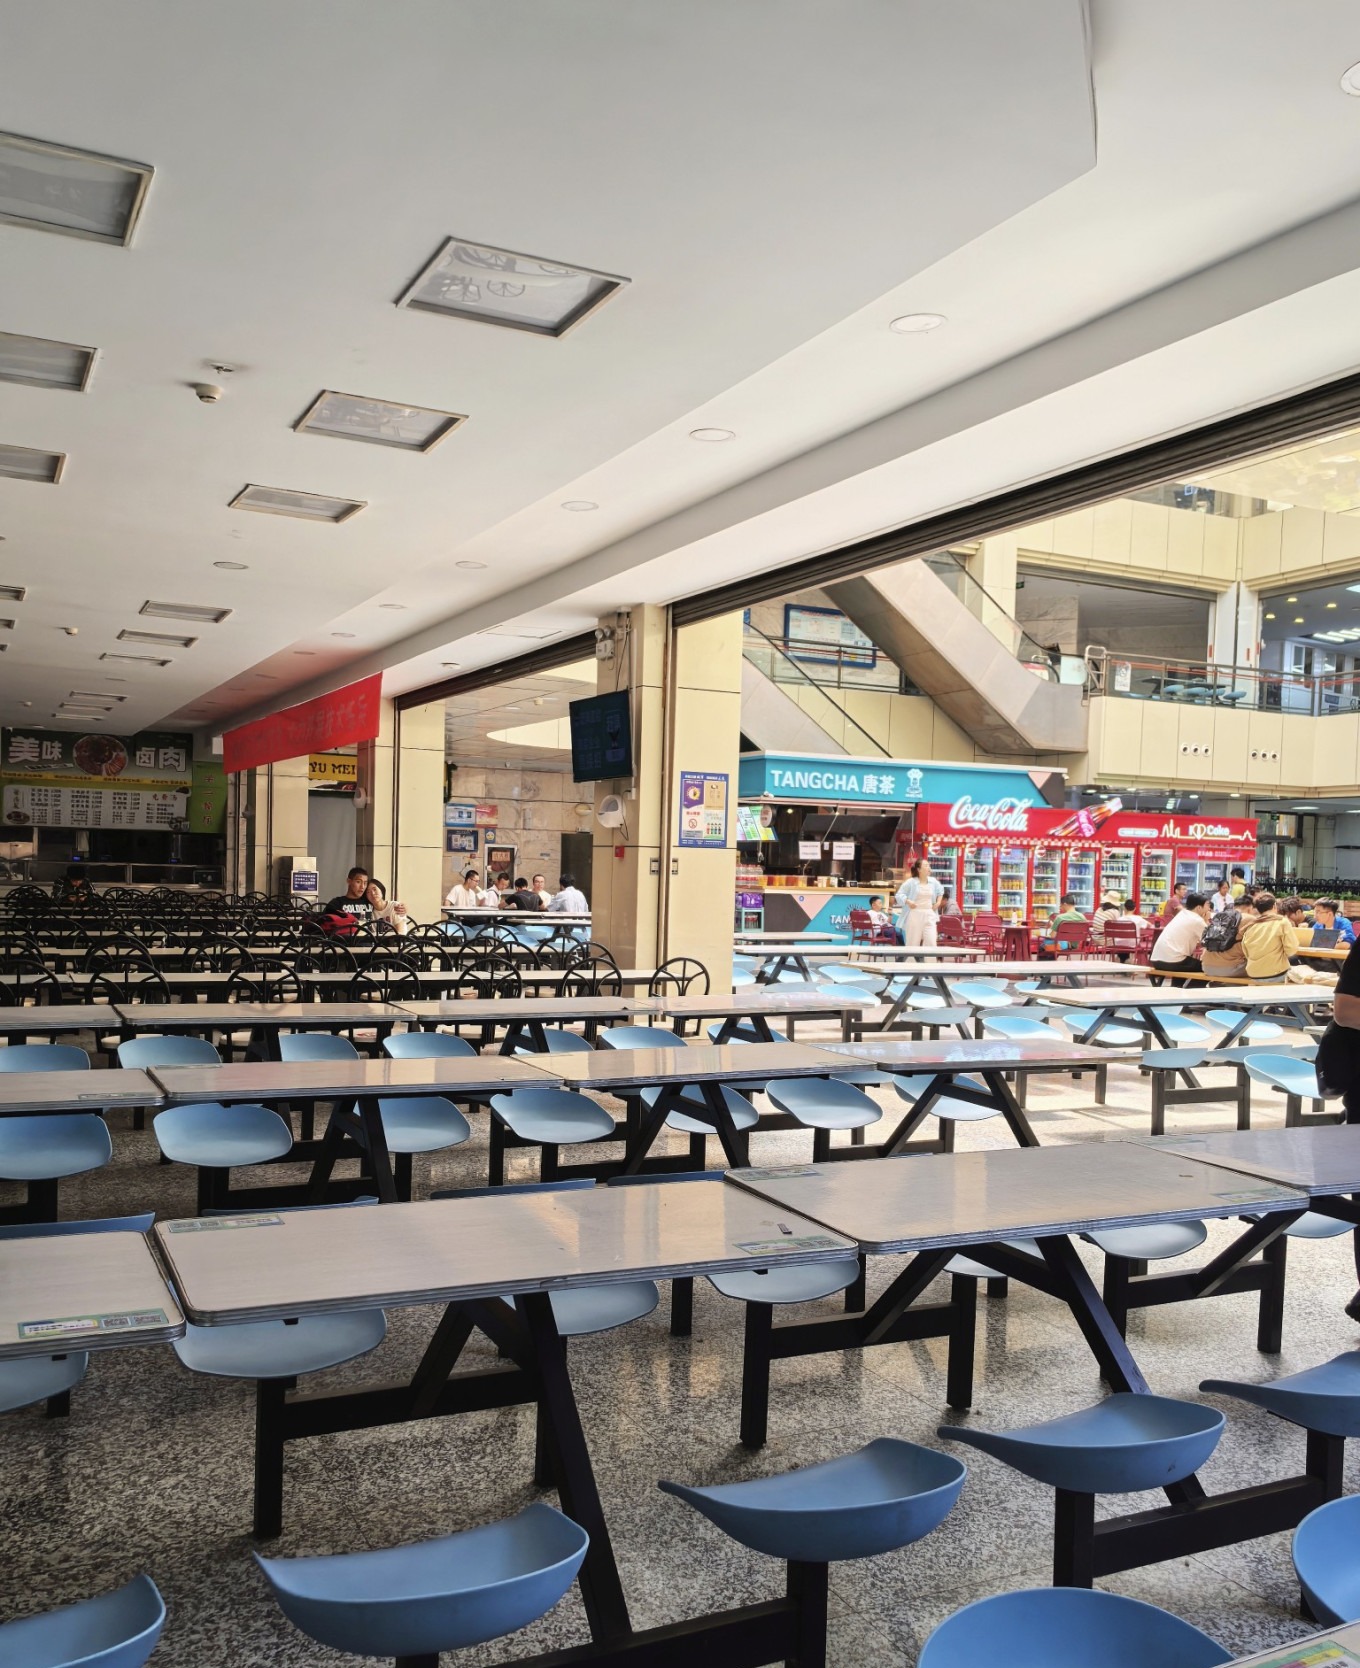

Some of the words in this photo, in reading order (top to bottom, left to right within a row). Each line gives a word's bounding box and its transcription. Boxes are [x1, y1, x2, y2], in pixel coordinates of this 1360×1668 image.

[8, 736, 62, 764] 美味
[136, 746, 186, 773] 卤肉
[309, 762, 327, 773] YU
[331, 763, 356, 775] MEI
[770, 770, 859, 793] TANGCHA
[862, 774, 896, 795] 唐茶
[948, 795, 1034, 832] Coca-Cola
[1206, 825, 1230, 836] Coke
[342, 903, 374, 914] COLDPLA
[830, 914, 851, 924] TAN
